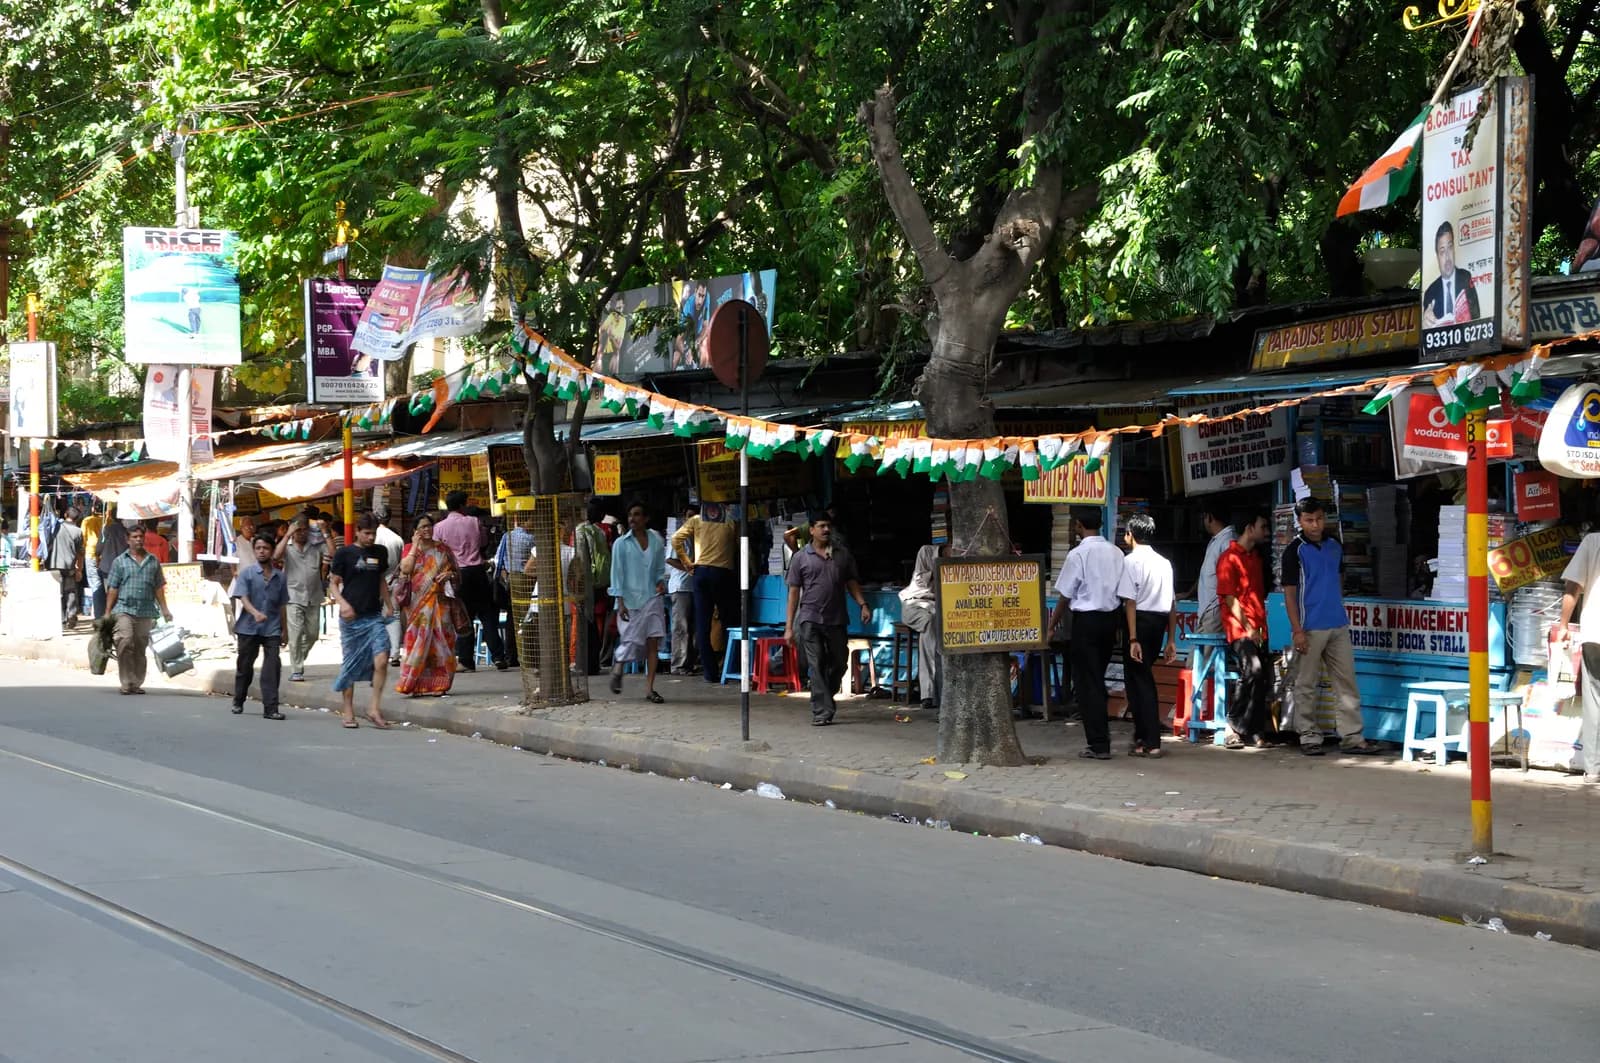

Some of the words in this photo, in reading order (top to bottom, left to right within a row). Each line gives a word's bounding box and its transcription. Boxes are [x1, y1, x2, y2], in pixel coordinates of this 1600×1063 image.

[1451, 148, 1471, 168] TAX
[1427, 166, 1494, 202] CONSULTANT
[316, 324, 332, 332] PGP
[1268, 323, 1326, 354] PARADISE
[1331, 316, 1366, 343] BOOK
[1370, 309, 1416, 337] STALL
[1426, 328, 1461, 348] 93310
[1464, 322, 1494, 342] 62733
[318, 347, 336, 356] MBA
[1198, 417, 1244, 438] COMPUTER
[1246, 412, 1272, 430] BOOKS
[1414, 428, 1460, 440] vodafone
[596, 460, 620, 473] MEDICAL
[1190, 462, 1208, 480] NEW
[1211, 455, 1245, 477] PARADISE
[1248, 452, 1264, 470] BOOK
[596, 476, 617, 490] BOOKS
[1072, 458, 1104, 498] BOOKS
[1492, 541, 1531, 576] 60
[943, 566, 960, 584] NEW
[961, 564, 996, 583] PARADISE
[996, 564, 1016, 582] BOOK
[1016, 562, 1038, 580] SHOP
[968, 584, 992, 598] SHOP
[955, 598, 992, 610] AVAILABLE
[1002, 597, 1020, 608] HERE
[1372, 606, 1382, 627] &
[1349, 630, 1392, 648] ARADISE
[1397, 632, 1426, 650] BOOK
[1430, 634, 1466, 653] STALL
